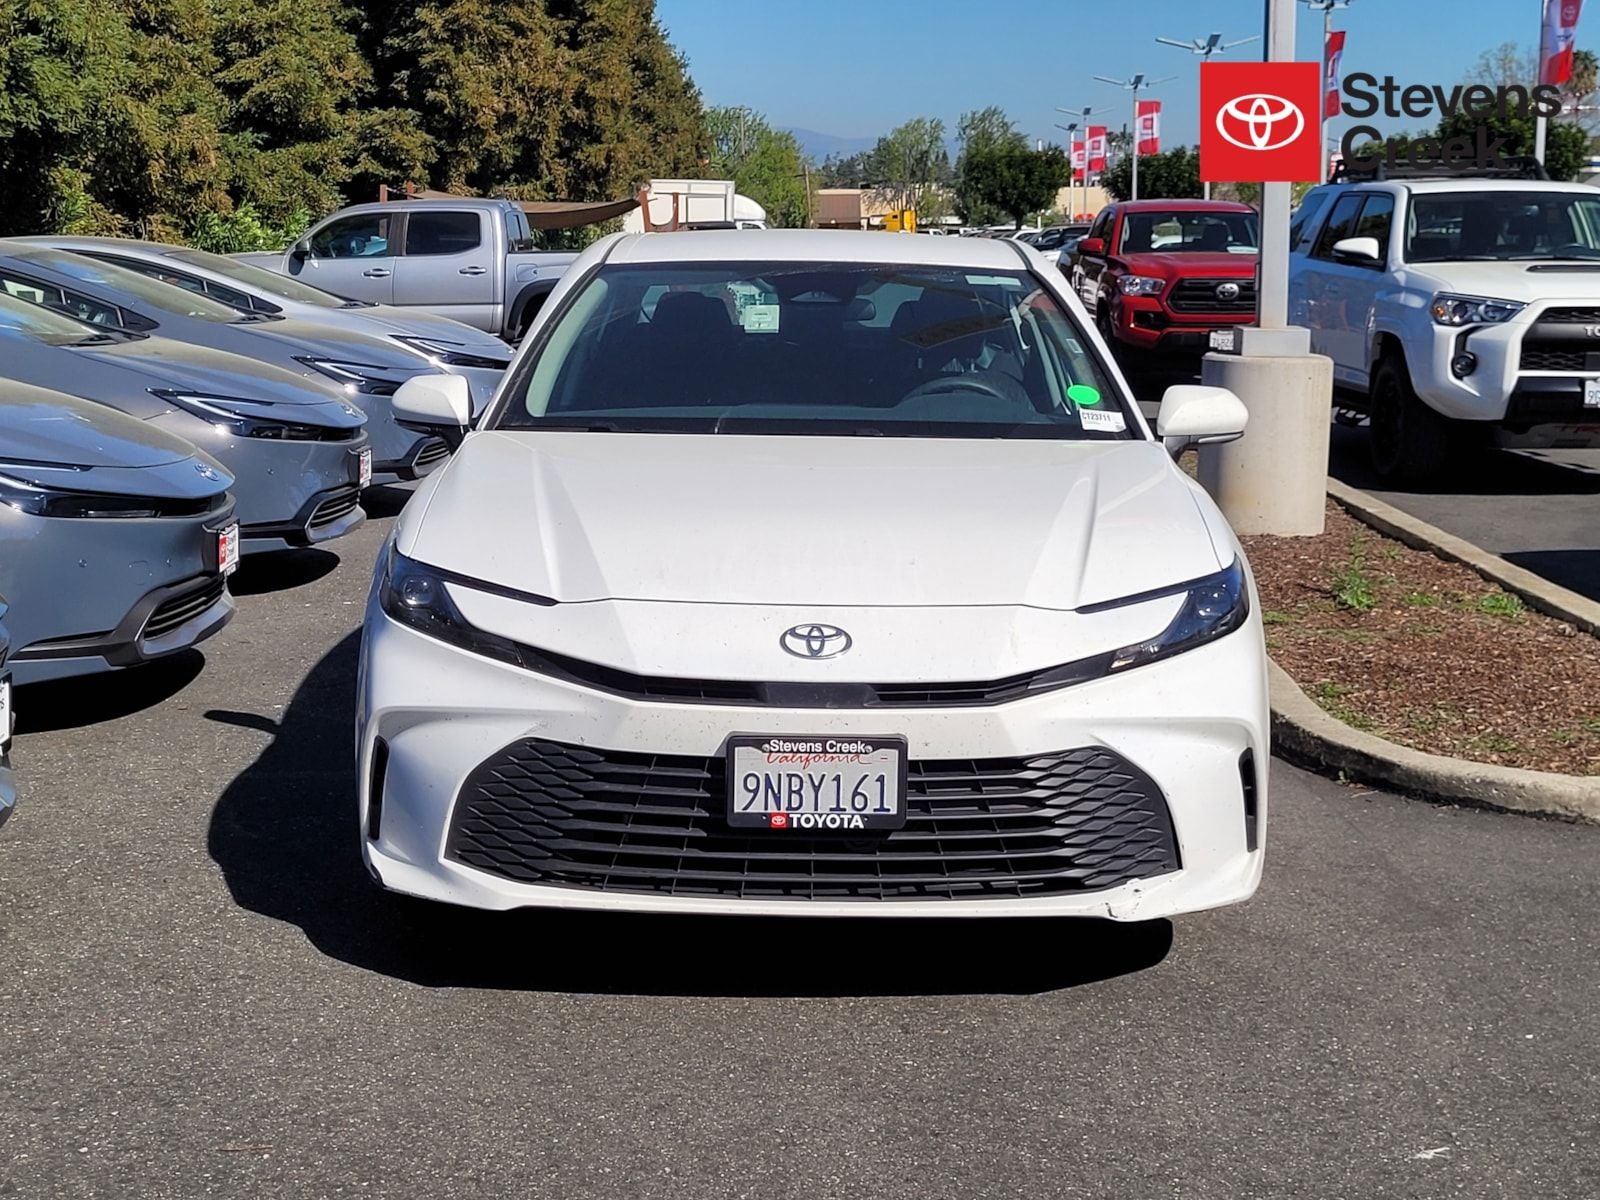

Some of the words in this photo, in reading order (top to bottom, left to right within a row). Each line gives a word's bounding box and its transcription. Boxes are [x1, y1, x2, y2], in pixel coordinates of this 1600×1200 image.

[769, 739, 823, 753] Stevens
[826, 740, 865, 753] Creek
[767, 752, 873, 769] California
[742, 773, 890, 812] 9NBY161
[790, 814, 864, 829] TOYOTA
